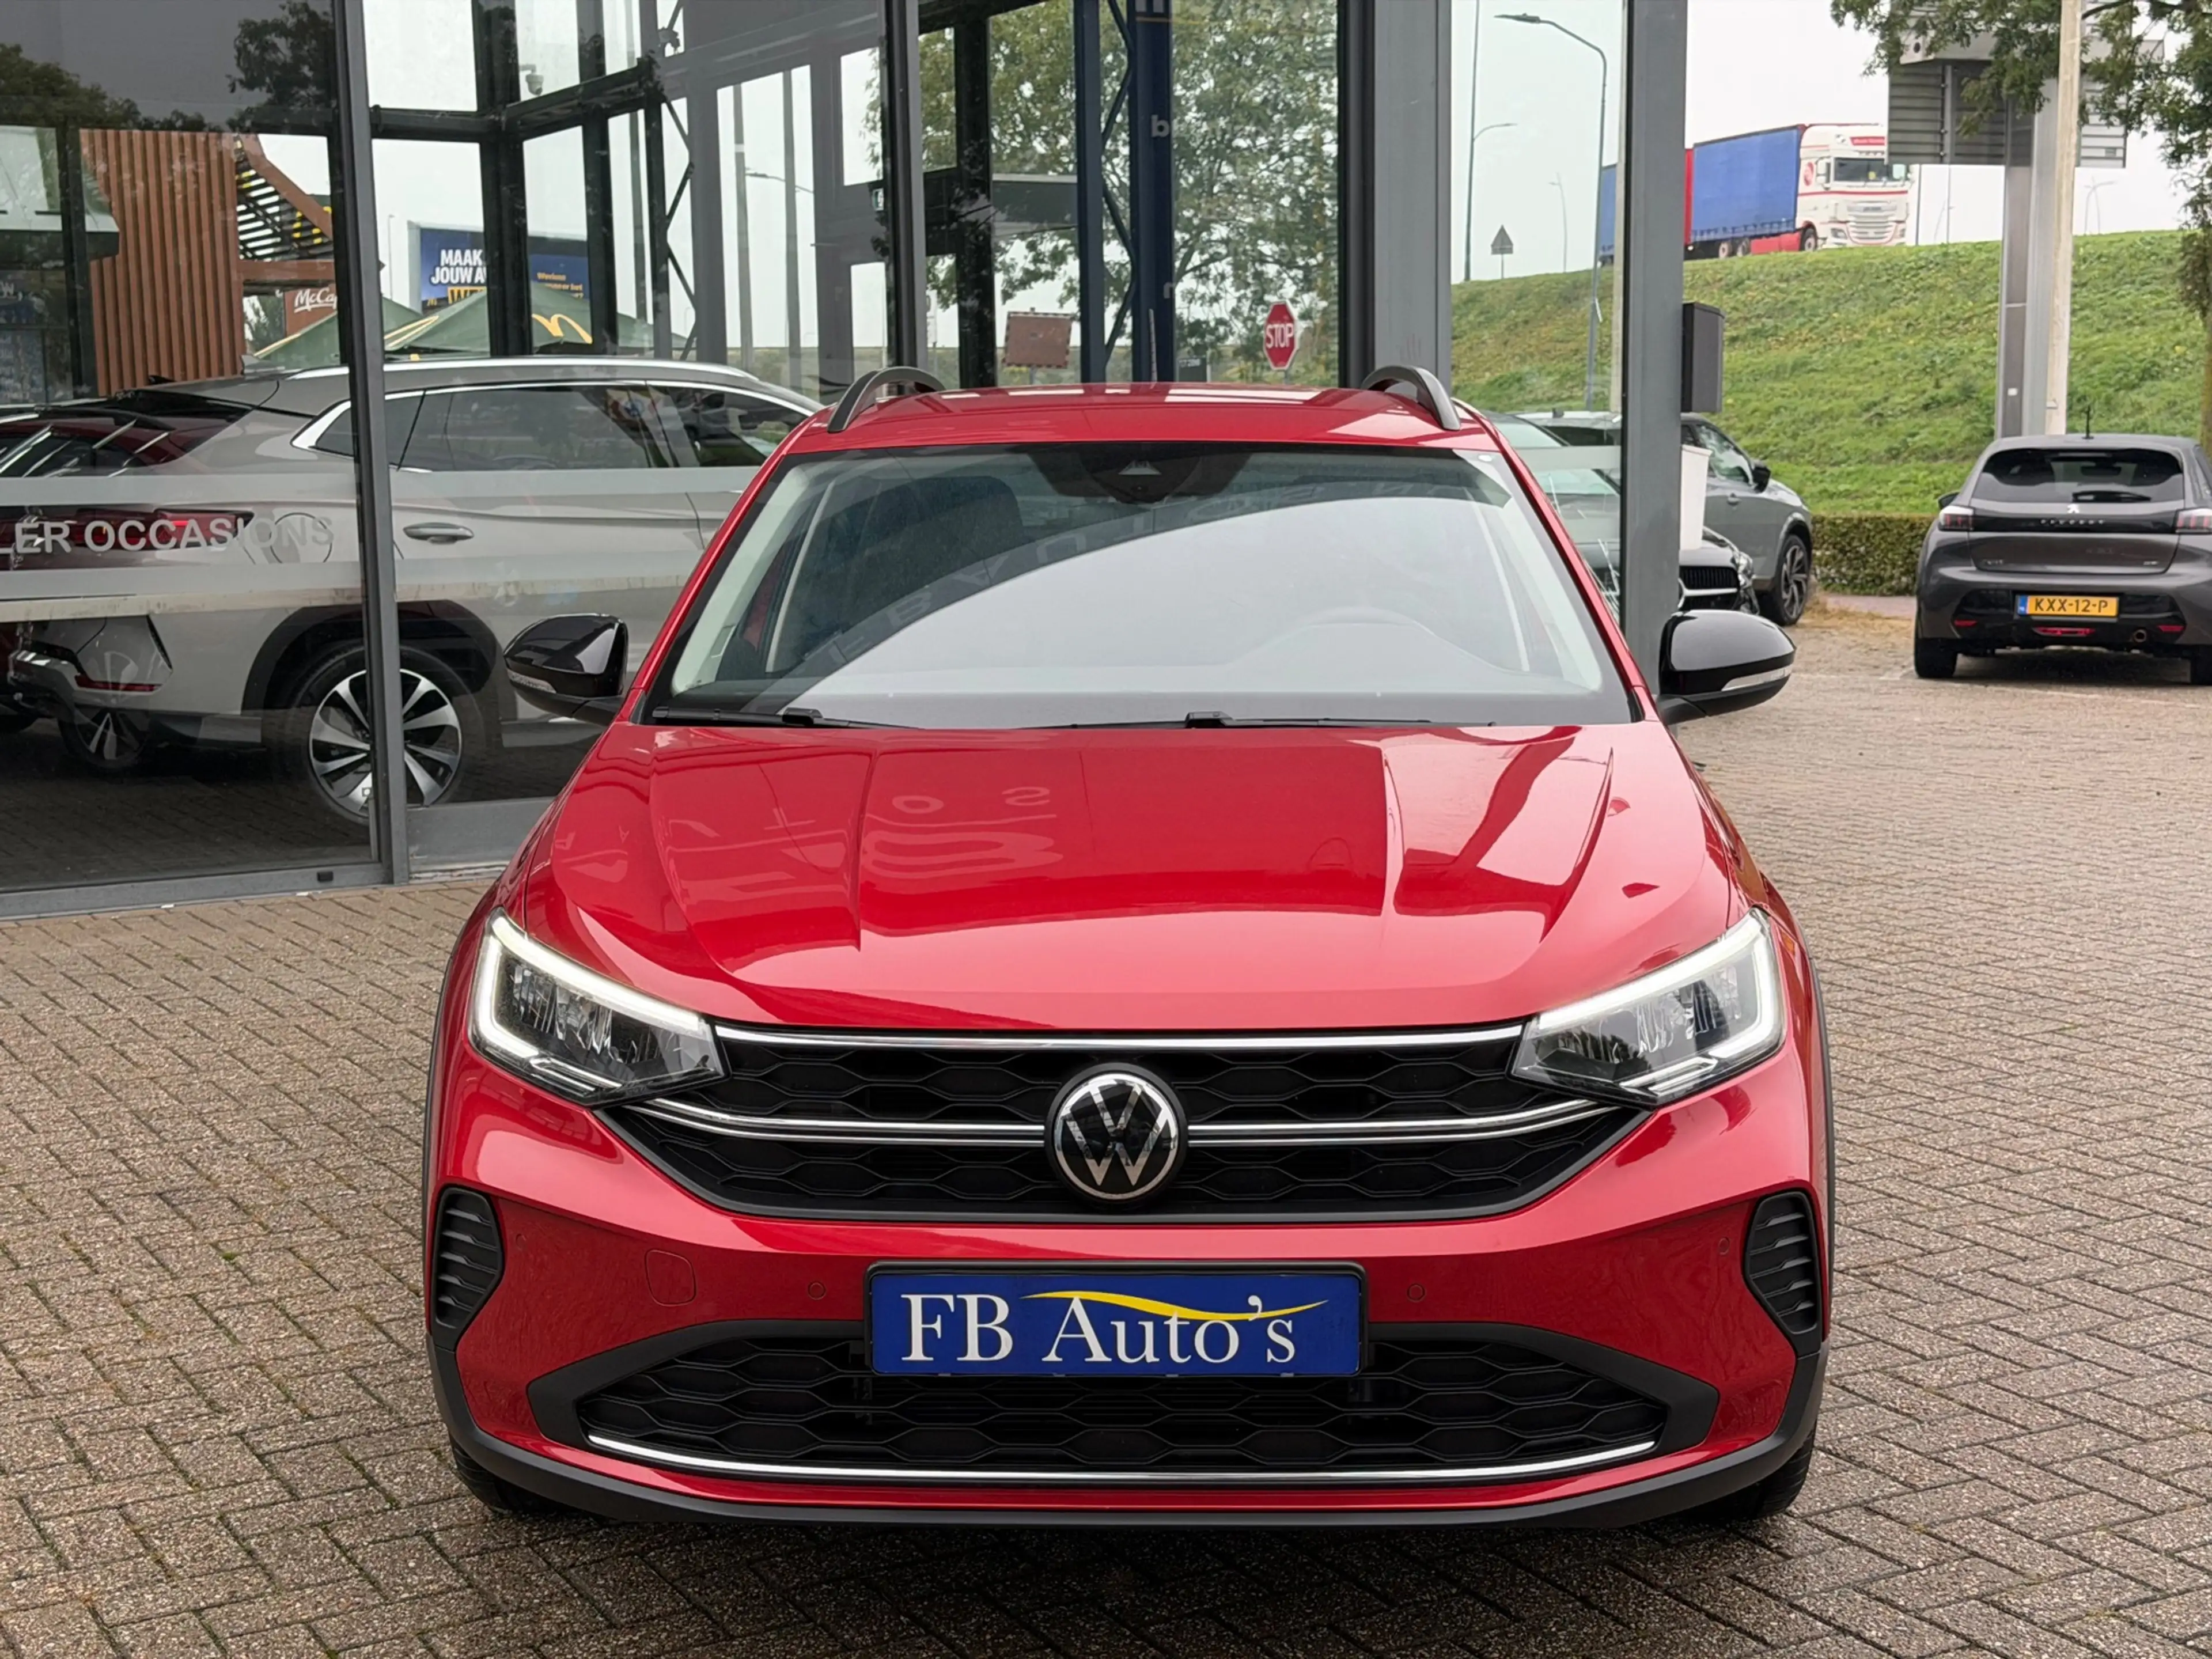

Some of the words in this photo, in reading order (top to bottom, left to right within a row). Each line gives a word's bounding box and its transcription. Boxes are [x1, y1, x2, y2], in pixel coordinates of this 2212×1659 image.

[440, 249, 483, 266] MAAK
[430, 266, 473, 284] JOUW
[1266, 323, 1294, 349] STOP
[84, 516, 335, 552] OCCASIONS
[2035, 598, 2108, 613] KXX-12-P
[900, 1294, 1013, 1362] FB
[1041, 1294, 1296, 1363] Auto's
